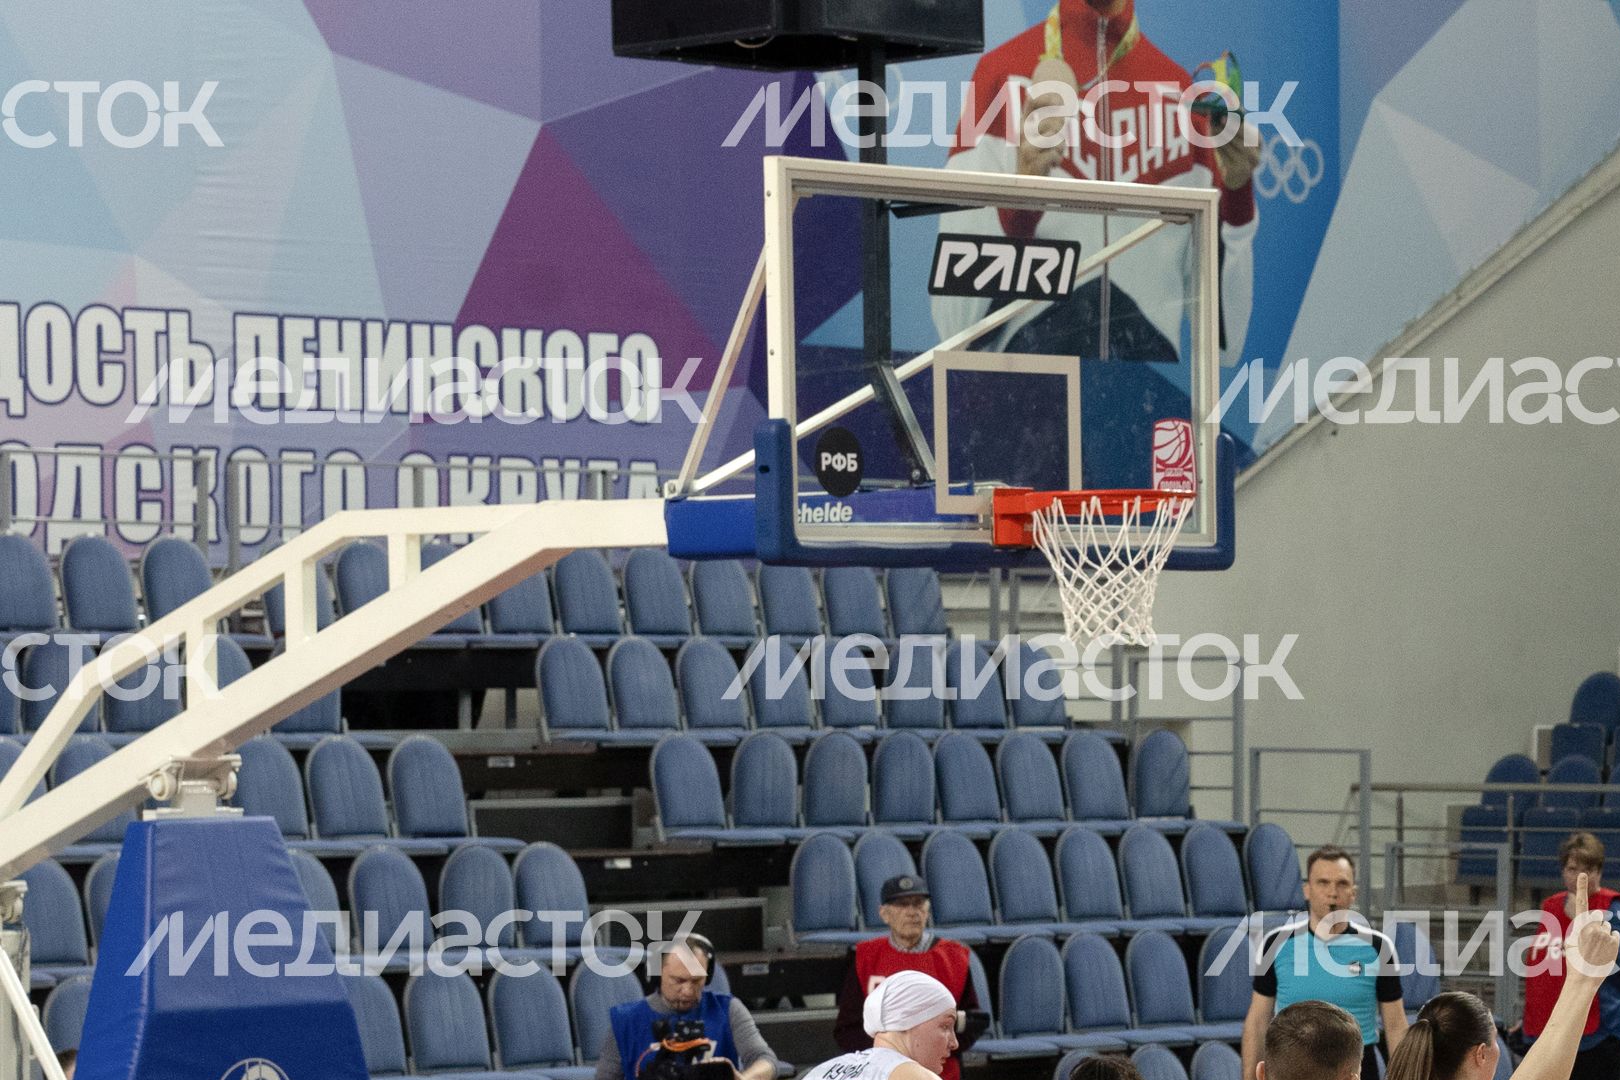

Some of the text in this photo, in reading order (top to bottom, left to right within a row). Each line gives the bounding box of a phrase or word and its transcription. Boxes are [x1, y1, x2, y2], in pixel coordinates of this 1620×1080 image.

[933, 240, 1076, 295] PARI
[229, 312, 662, 425] ЛЕНИНСКОГО
[821, 451, 858, 473] РФБ
